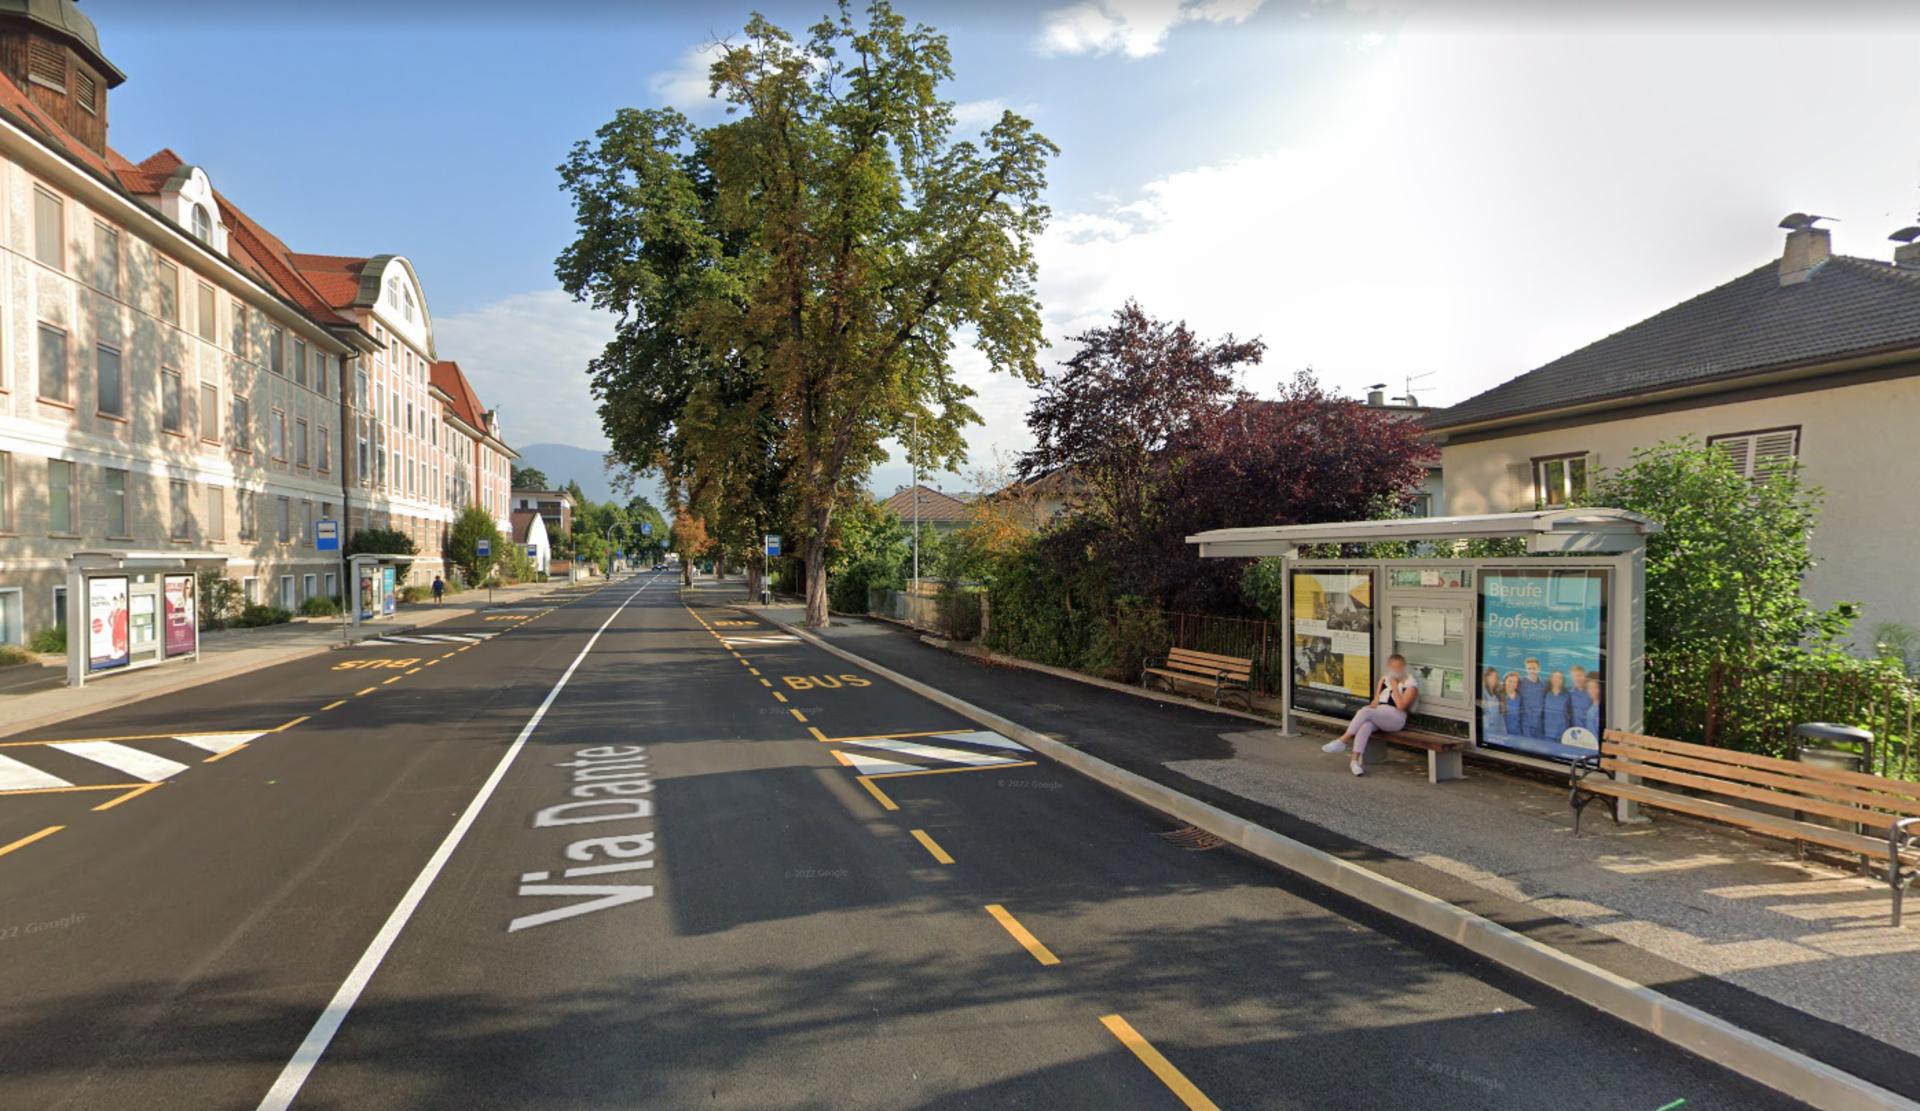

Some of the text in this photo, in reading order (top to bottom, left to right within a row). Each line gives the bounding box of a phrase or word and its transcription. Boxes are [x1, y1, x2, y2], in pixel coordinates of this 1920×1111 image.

[1489, 582, 1542, 598] Berufe
[1488, 613, 1580, 633] Professioni
[782, 674, 872, 690] BUS
[508, 746, 656, 933] Via Dante
